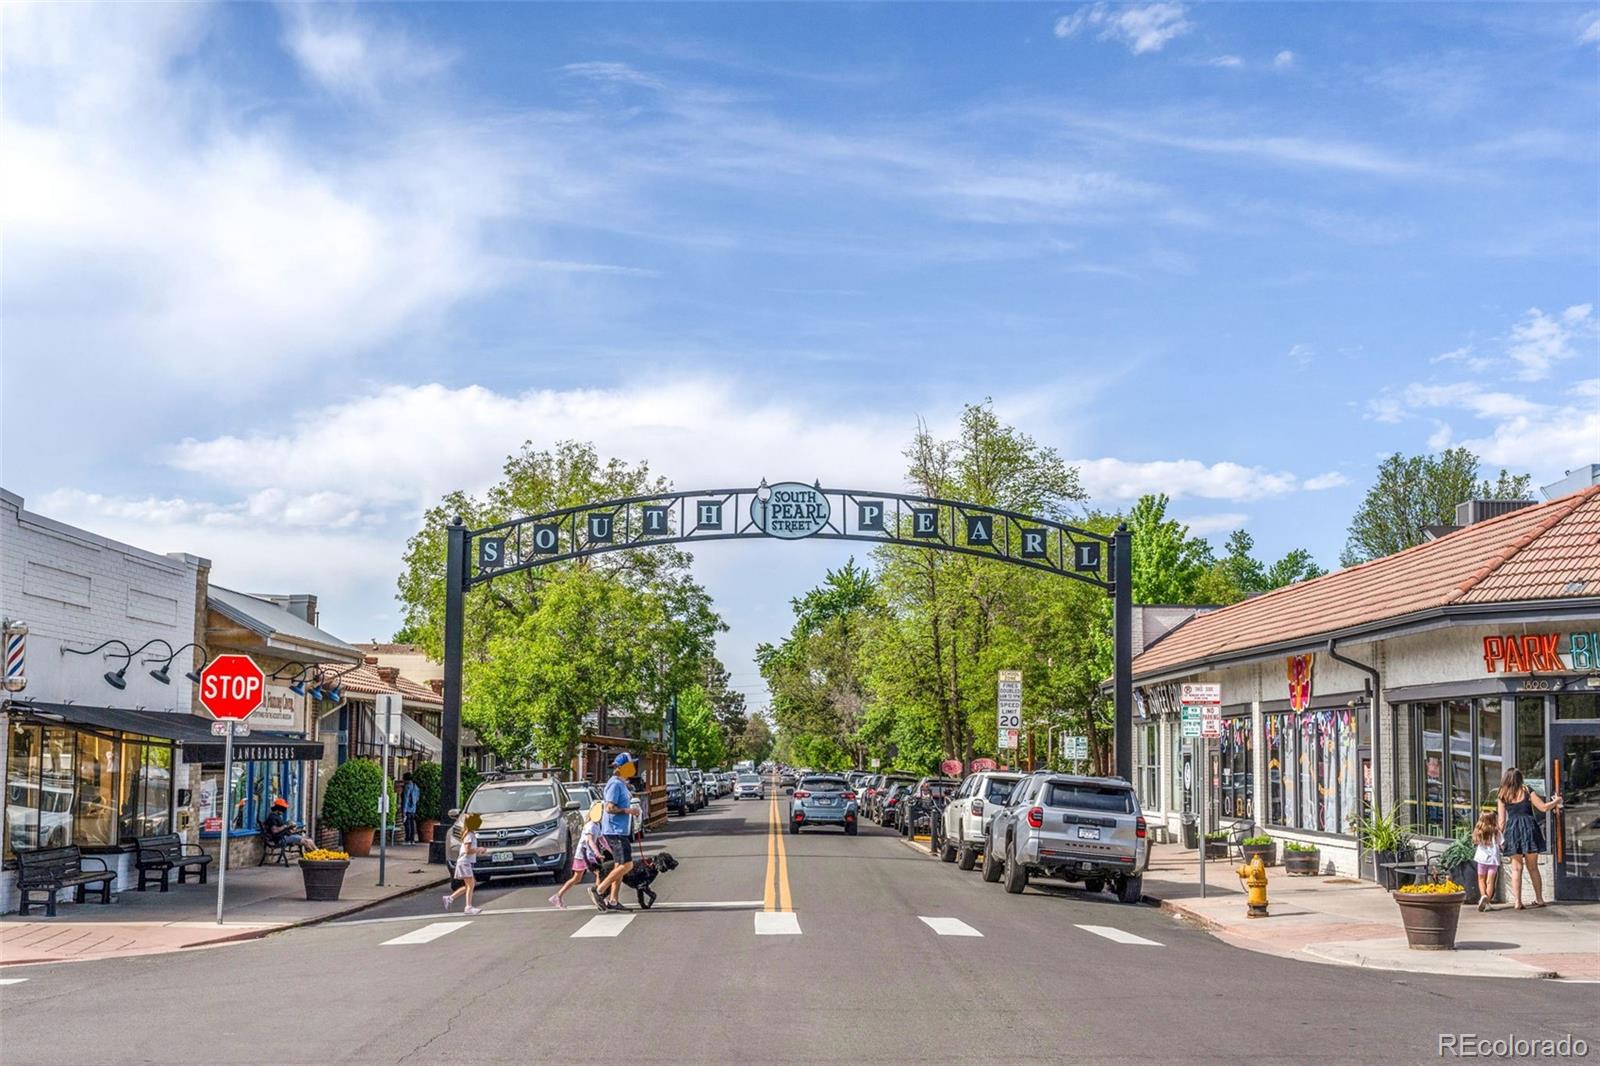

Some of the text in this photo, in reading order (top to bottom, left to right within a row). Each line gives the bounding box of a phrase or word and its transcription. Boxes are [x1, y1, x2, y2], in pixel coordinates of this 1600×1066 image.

[774, 491, 816, 503] SOUTH
[771, 504, 827, 525] PEARL
[771, 521, 812, 532] STREET
[1483, 633, 1566, 673] PARK
[204, 675, 260, 699] STOP
[1000, 715, 1019, 727] 20
